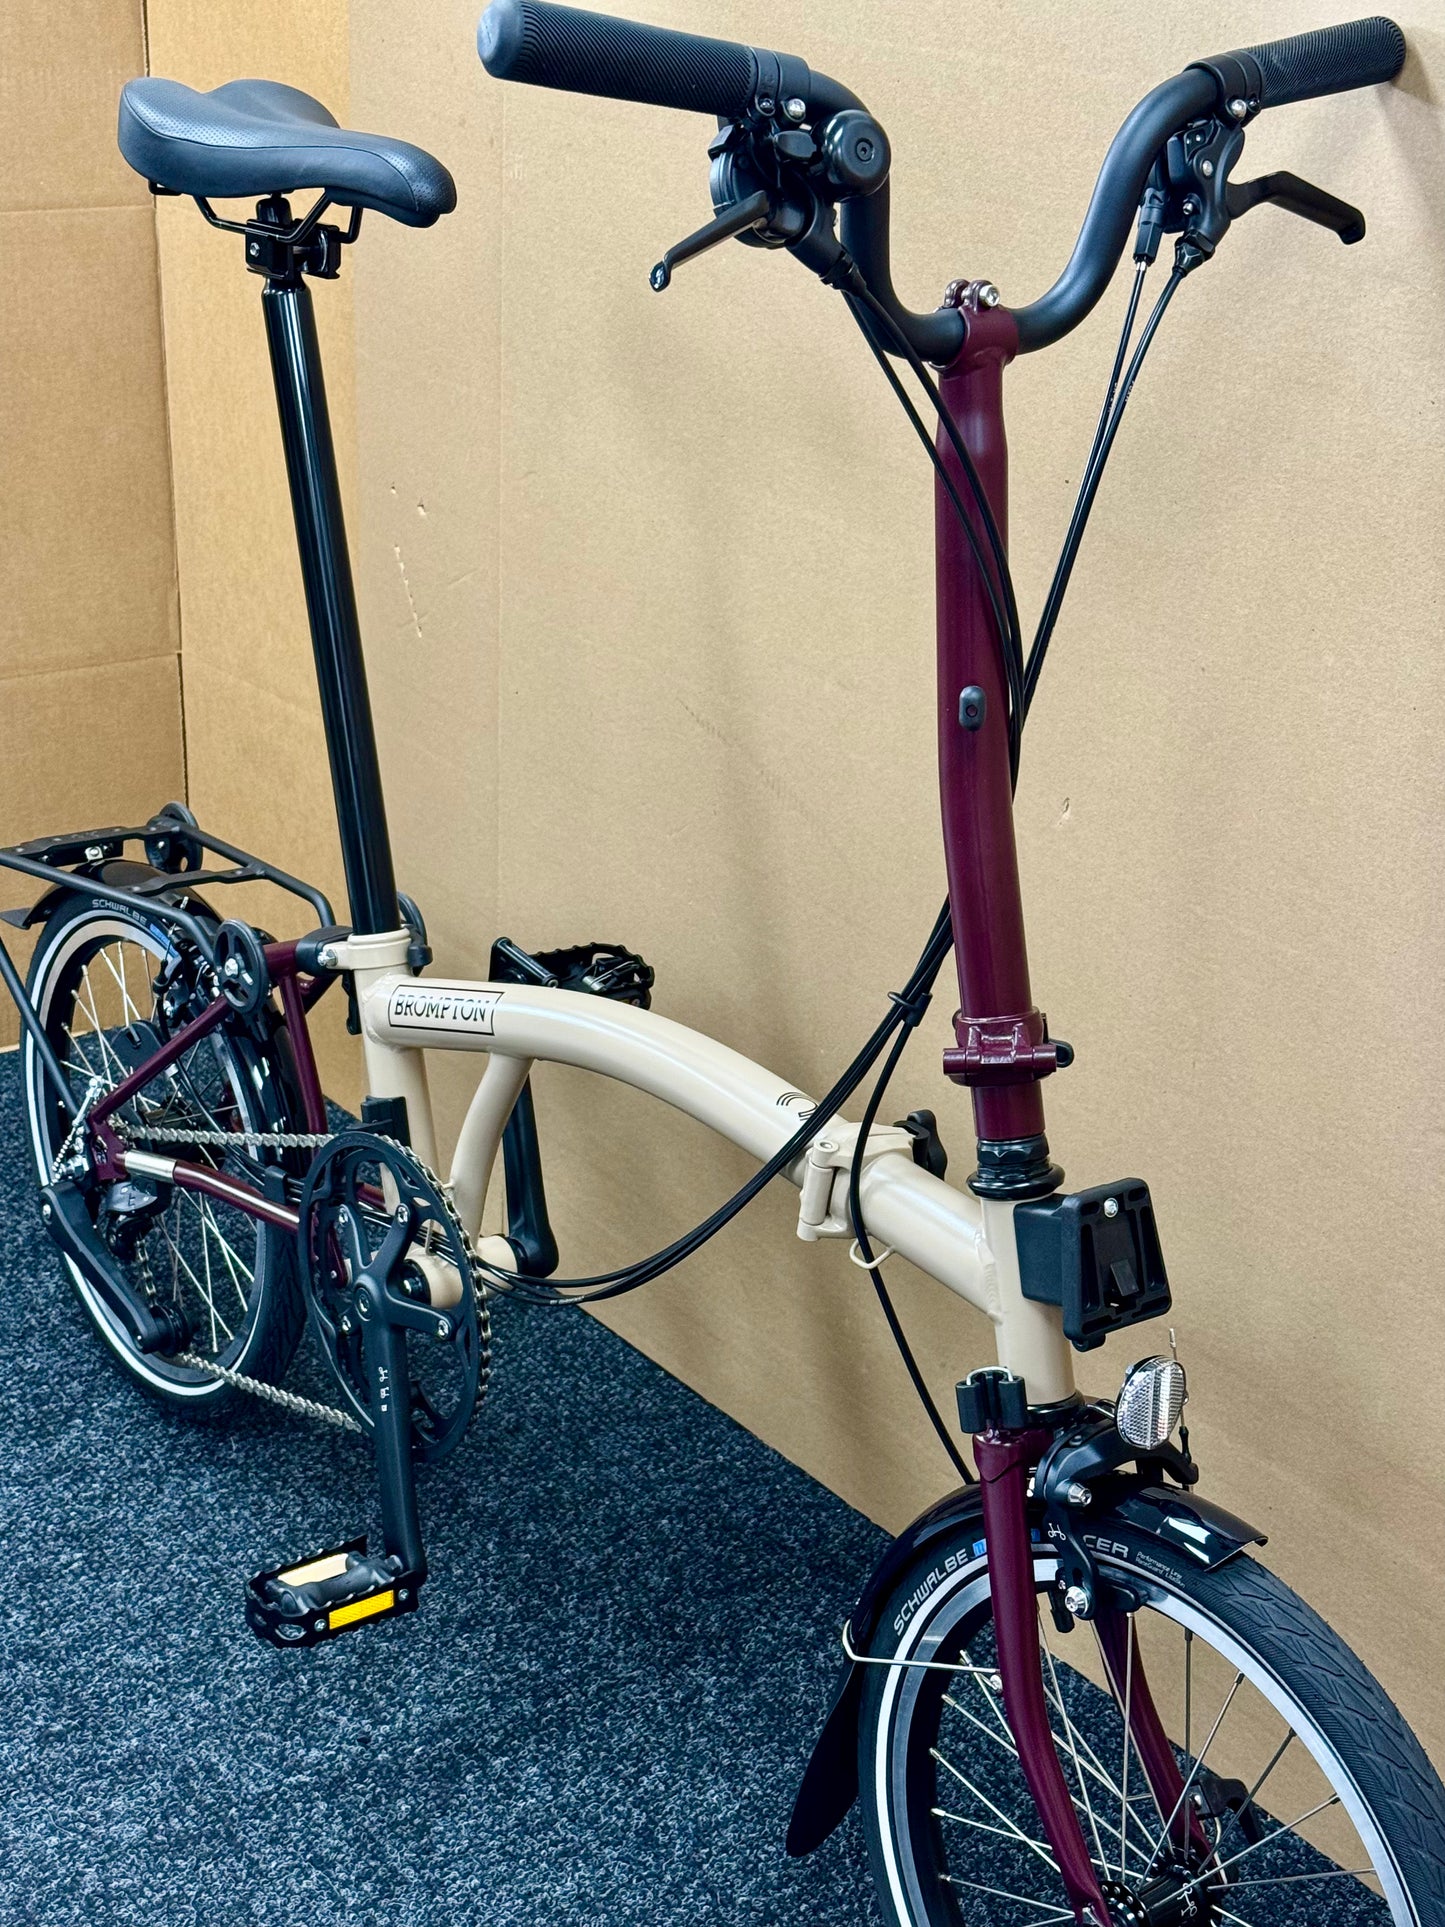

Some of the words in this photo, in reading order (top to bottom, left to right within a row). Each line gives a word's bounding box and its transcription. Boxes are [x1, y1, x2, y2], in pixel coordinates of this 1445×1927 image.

[92, 898, 148, 926] SCHWALBE
[394, 994, 490, 1022] BROMPTON
[1082, 1534, 1129, 1558] CER
[893, 1548, 969, 1637] SCHWALBE
